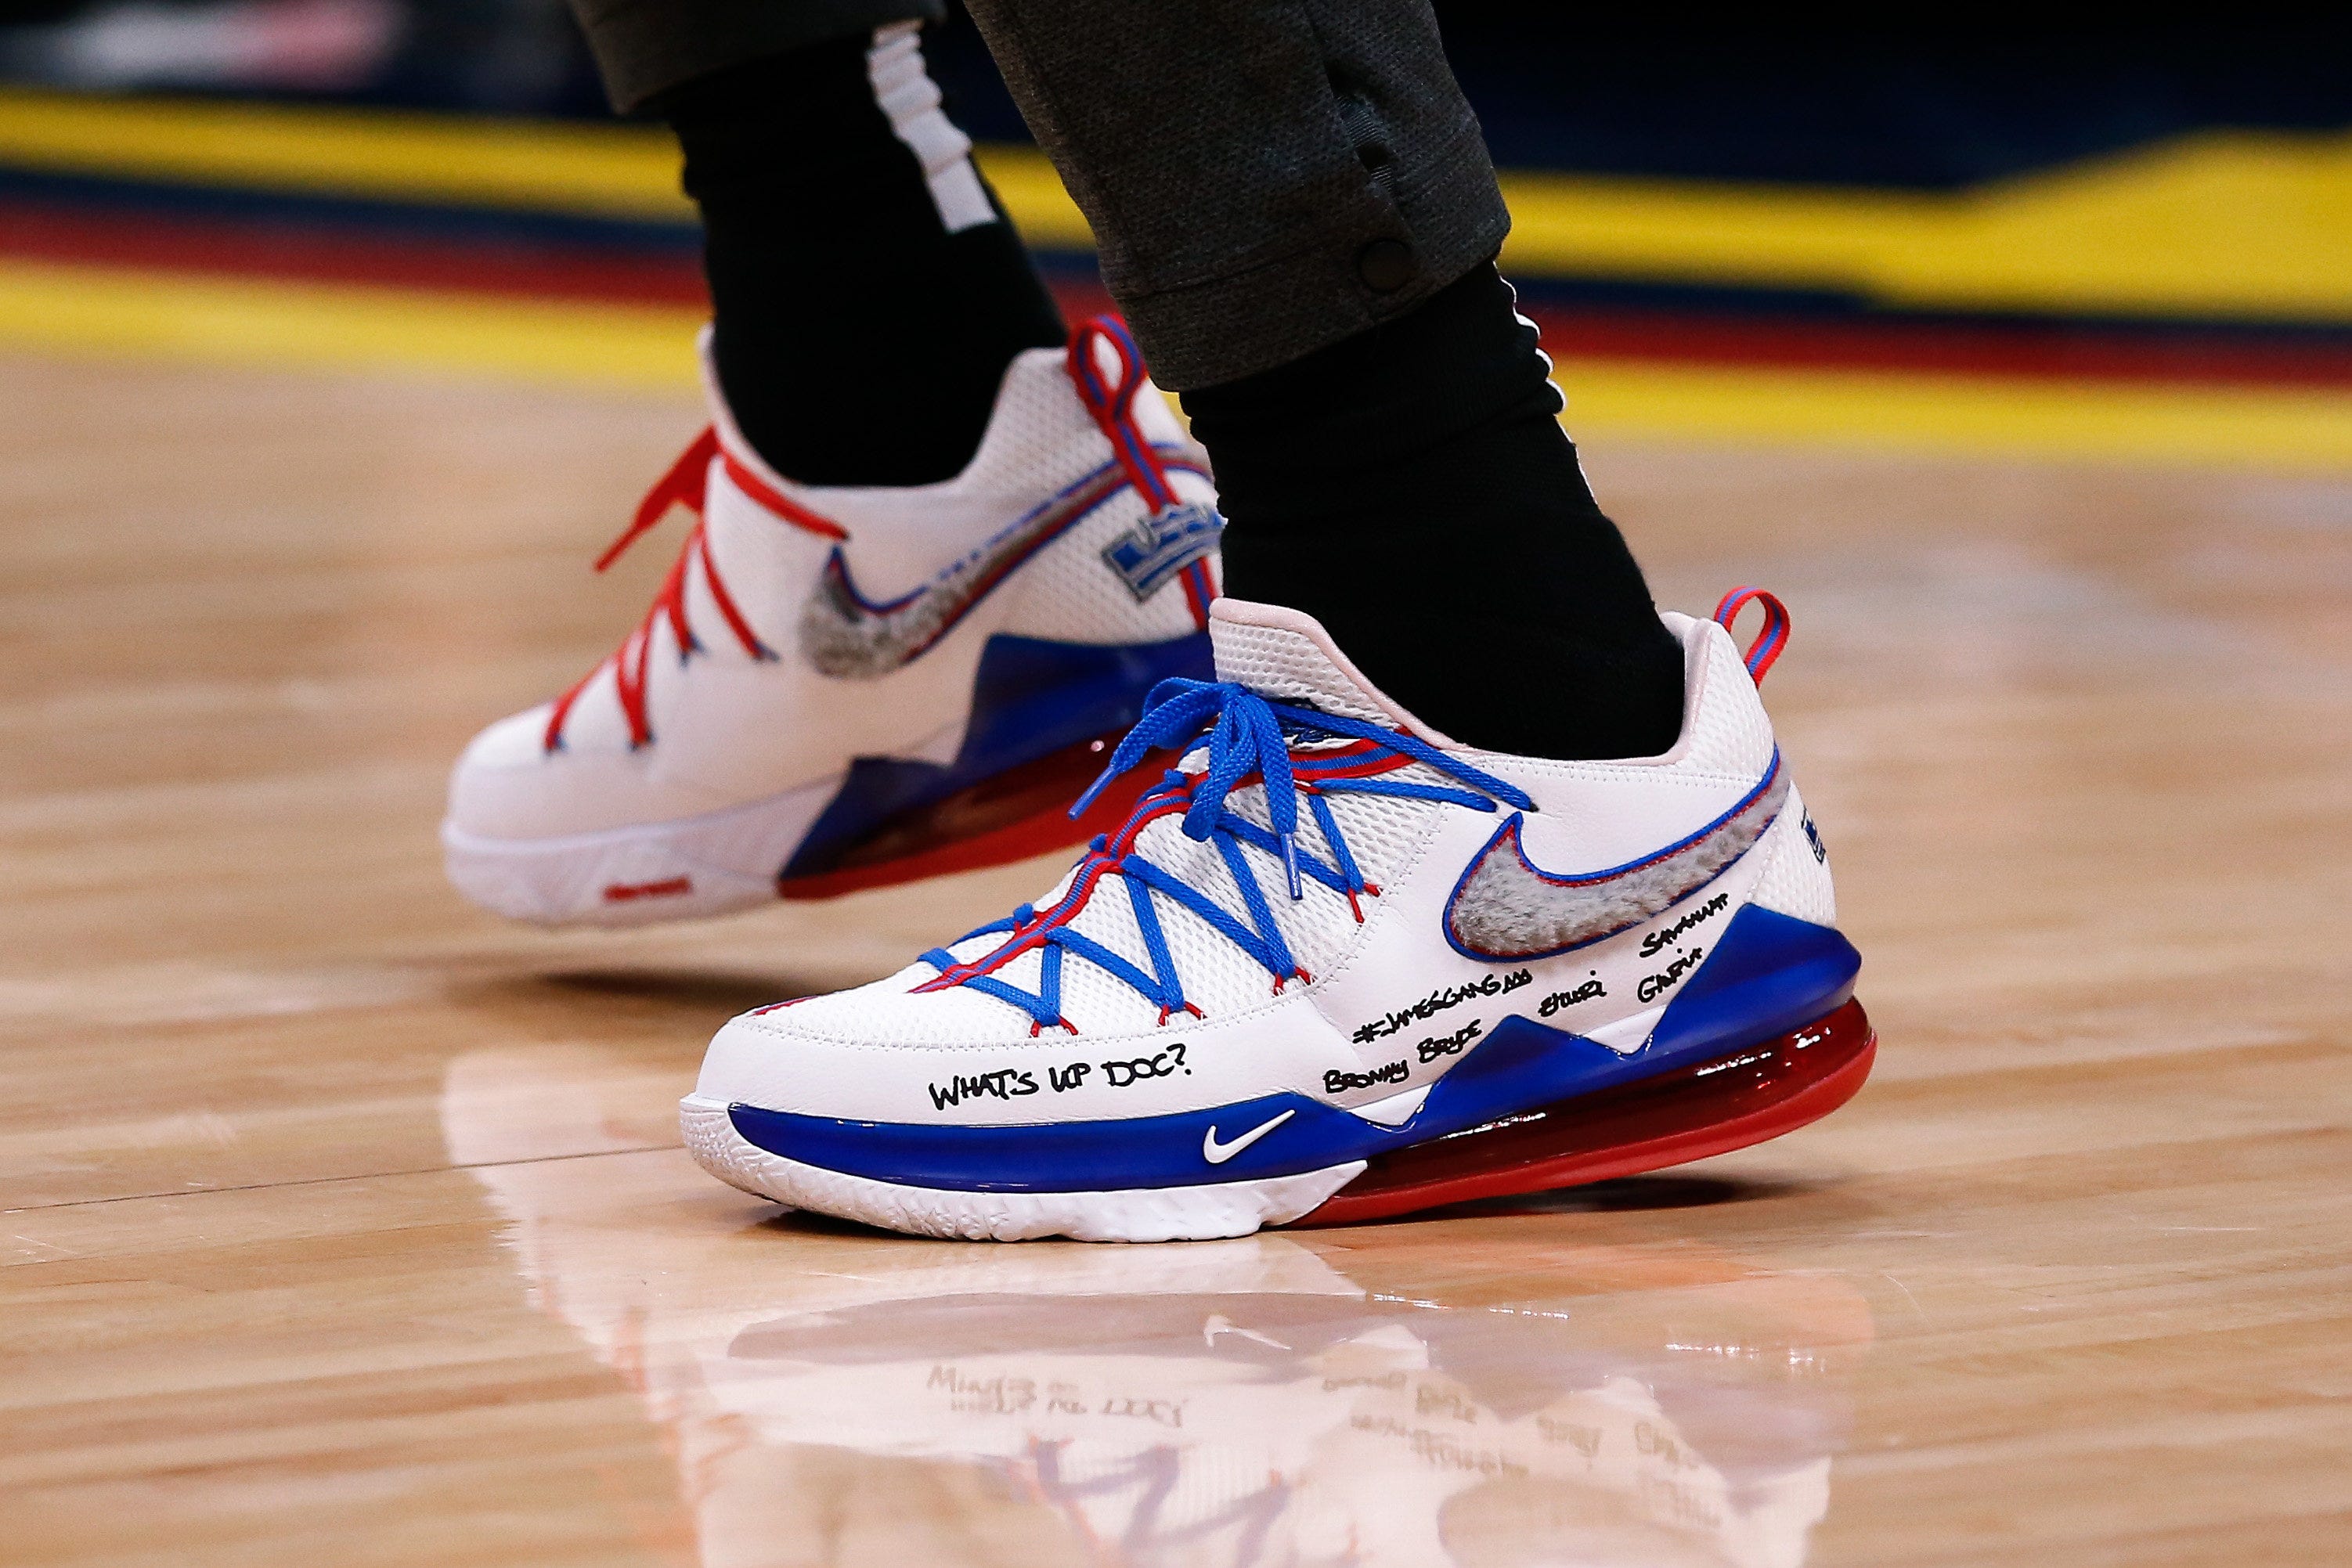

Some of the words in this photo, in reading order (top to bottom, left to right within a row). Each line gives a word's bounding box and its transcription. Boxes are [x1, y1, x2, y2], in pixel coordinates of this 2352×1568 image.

[1048, 1062, 1091, 1093] UP
[1100, 1043, 1192, 1087] DOC?
[1322, 1059, 1410, 1094] BRONNY
